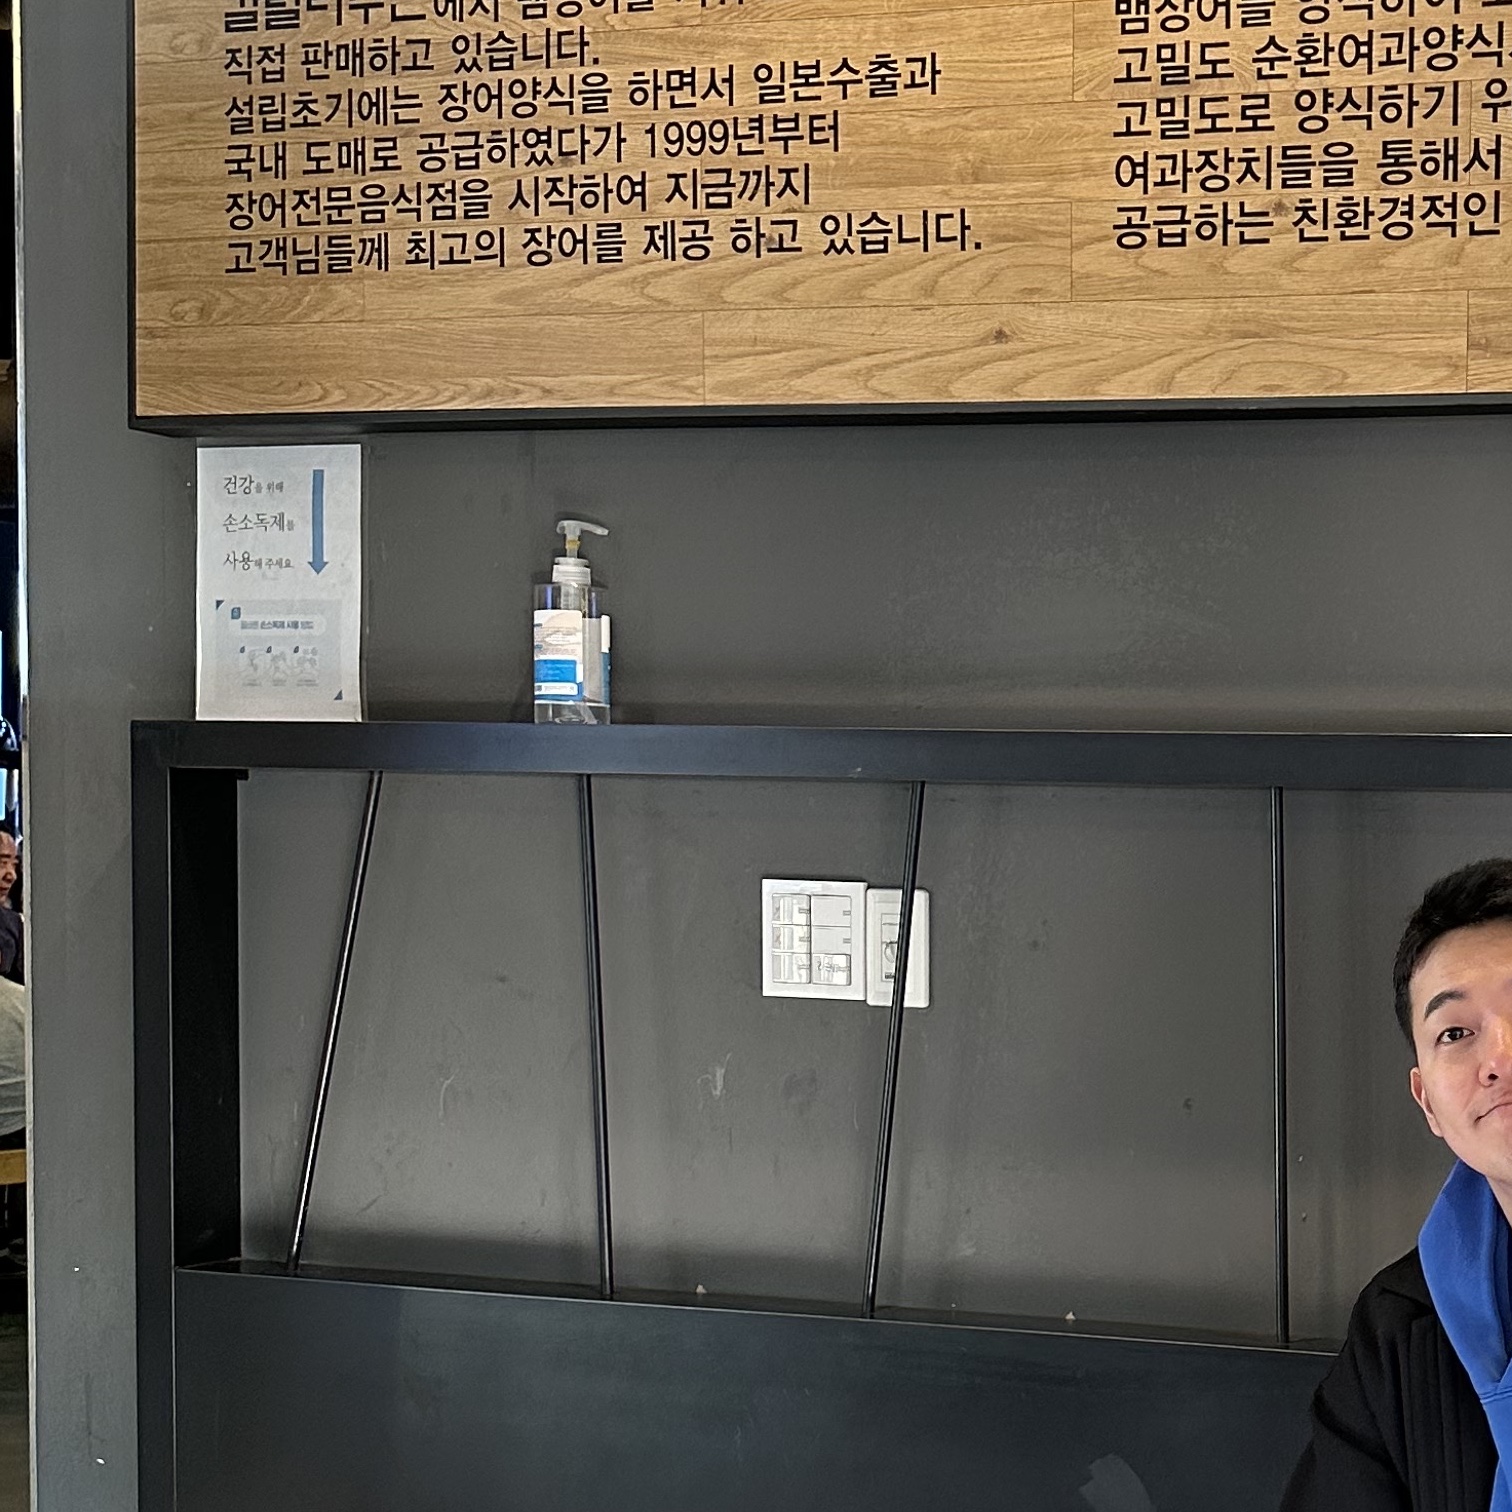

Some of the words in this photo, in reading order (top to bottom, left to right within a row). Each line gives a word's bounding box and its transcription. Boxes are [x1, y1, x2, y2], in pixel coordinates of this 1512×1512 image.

[224, 43, 285, 85] 직접
[301, 36, 434, 80] 판매하고
[452, 26, 599, 73] 있습니다.
[1114, 40, 1234, 85] 고밀도
[225, 86, 422, 135] 설립초기에는
[438, 73, 612, 122] 장어양식을
[628, 65, 733, 110] 하면서
[754, 53, 941, 104] 일본수출과
[1114, 94, 1274, 139] 고밀도로
[1295, 81, 1459, 133] 양식하기
[225, 141, 286, 182] 국내
[303, 136, 401, 176] 도매로
[417, 122, 626, 172] 공급하였다가
[645, 110, 838, 157] 1999년부터
[1116, 142, 1358, 194] 여과장치들을
[1377, 135, 1501, 185] 통해서
[225, 179, 492, 230] 장어전문음식점을
[508, 171, 646, 216] 시작하여
[665, 163, 809, 209] 지금까지
[1113, 202, 1273, 249] 공급하는
[1292, 190, 1500, 242] 친환경적인
[225, 232, 389, 275] 고객님들께
[406, 227, 504, 270] 최고의
[522, 223, 626, 266] 장어를
[643, 220, 713, 261] 제공
[730, 217, 802, 258] 하고
[820, 209, 981, 255] 있습니다.
